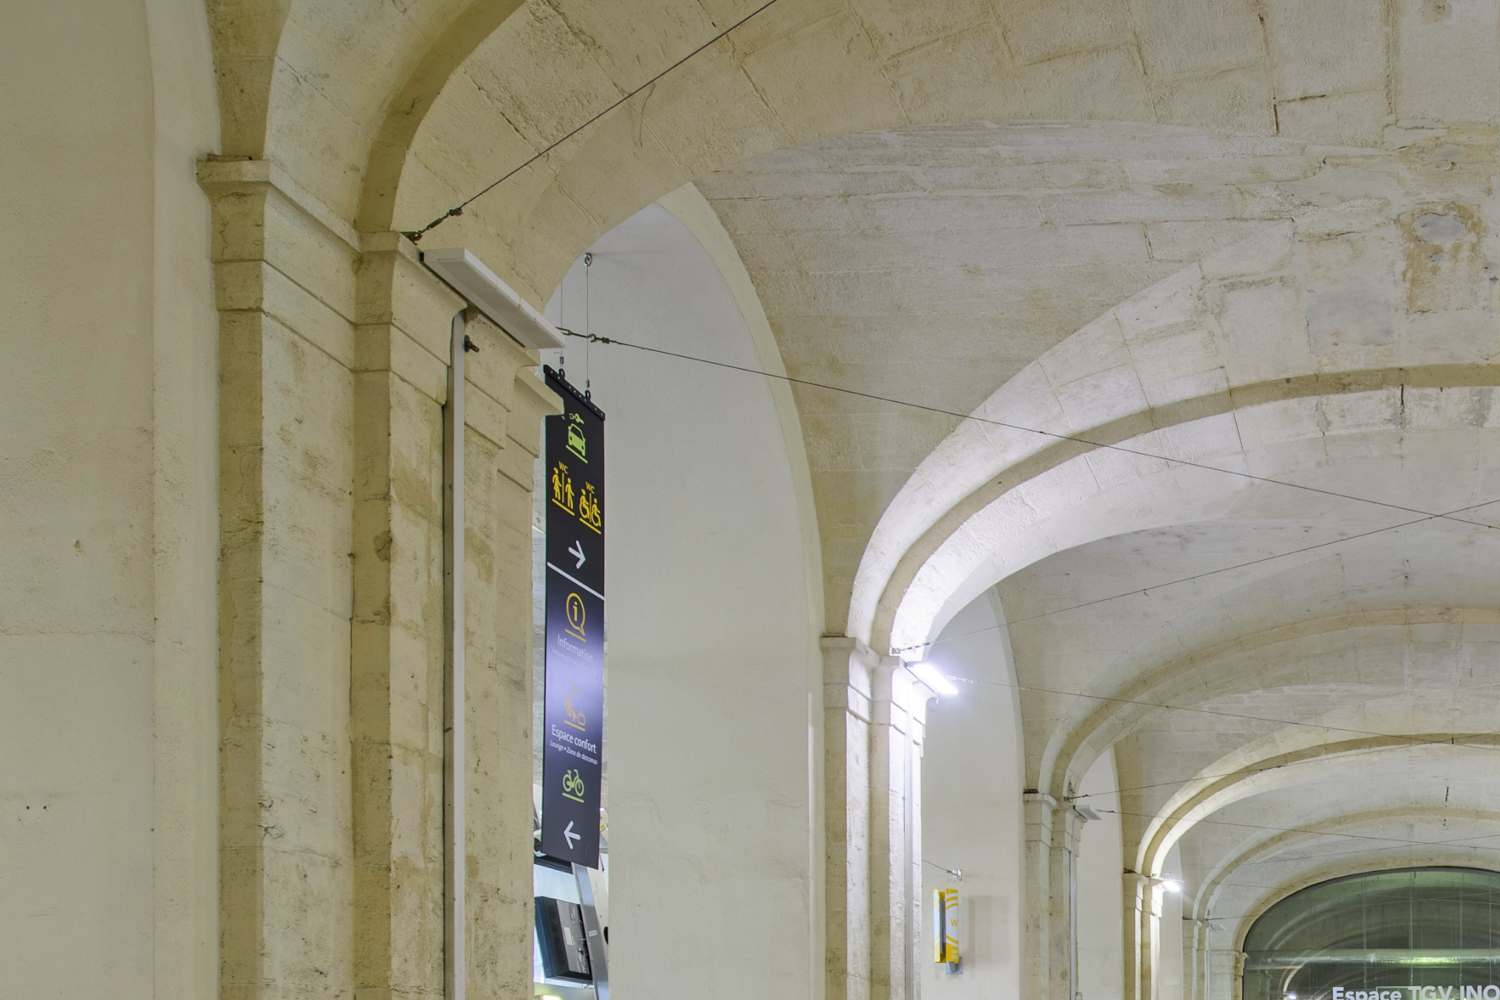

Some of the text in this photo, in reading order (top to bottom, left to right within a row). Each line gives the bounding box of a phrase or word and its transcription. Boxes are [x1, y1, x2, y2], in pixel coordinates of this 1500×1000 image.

[558, 461, 568, 474] WC
[586, 481, 595, 494] WC
[557, 634, 593, 662] Information
[551, 724, 597, 754] Espace confort
